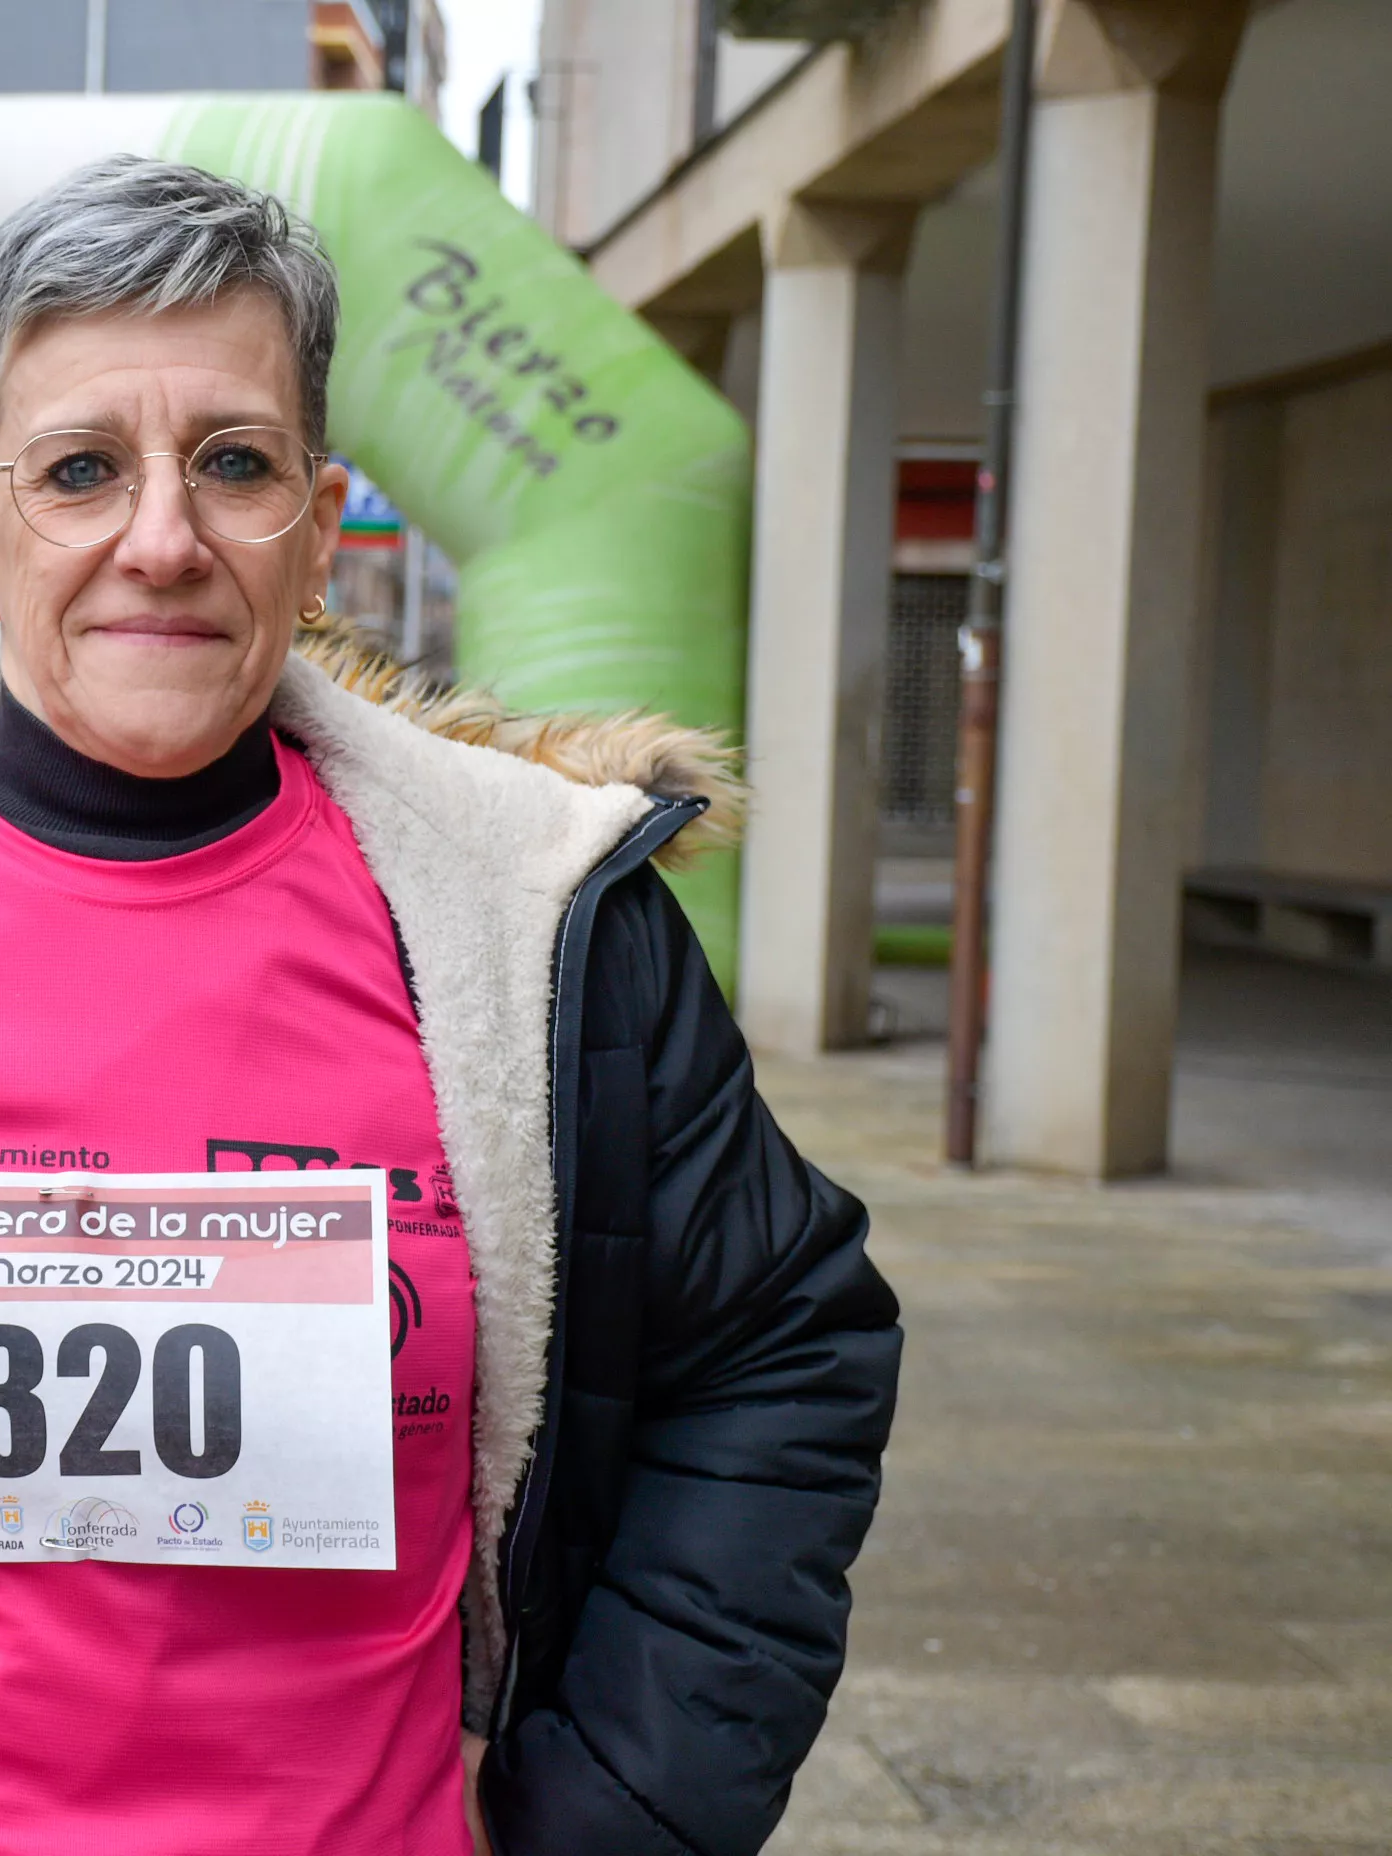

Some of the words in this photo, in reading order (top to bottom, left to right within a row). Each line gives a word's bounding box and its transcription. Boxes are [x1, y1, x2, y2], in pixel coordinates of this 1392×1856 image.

[405, 236, 618, 443] Bierzo
[79, 1205, 137, 1237] de
[149, 1206, 187, 1238] la
[200, 1205, 342, 1250] mujer
[388, 1218, 460, 1238] PONFERRADA
[114, 1258, 206, 1287] 2024
[60, 1517, 138, 1538] Ponferrada
[281, 1517, 380, 1532] Ayuntamiento
[156, 1536, 183, 1546] Pacto
[192, 1536, 224, 1547] Estado
[281, 1533, 381, 1553] Ponferrada
